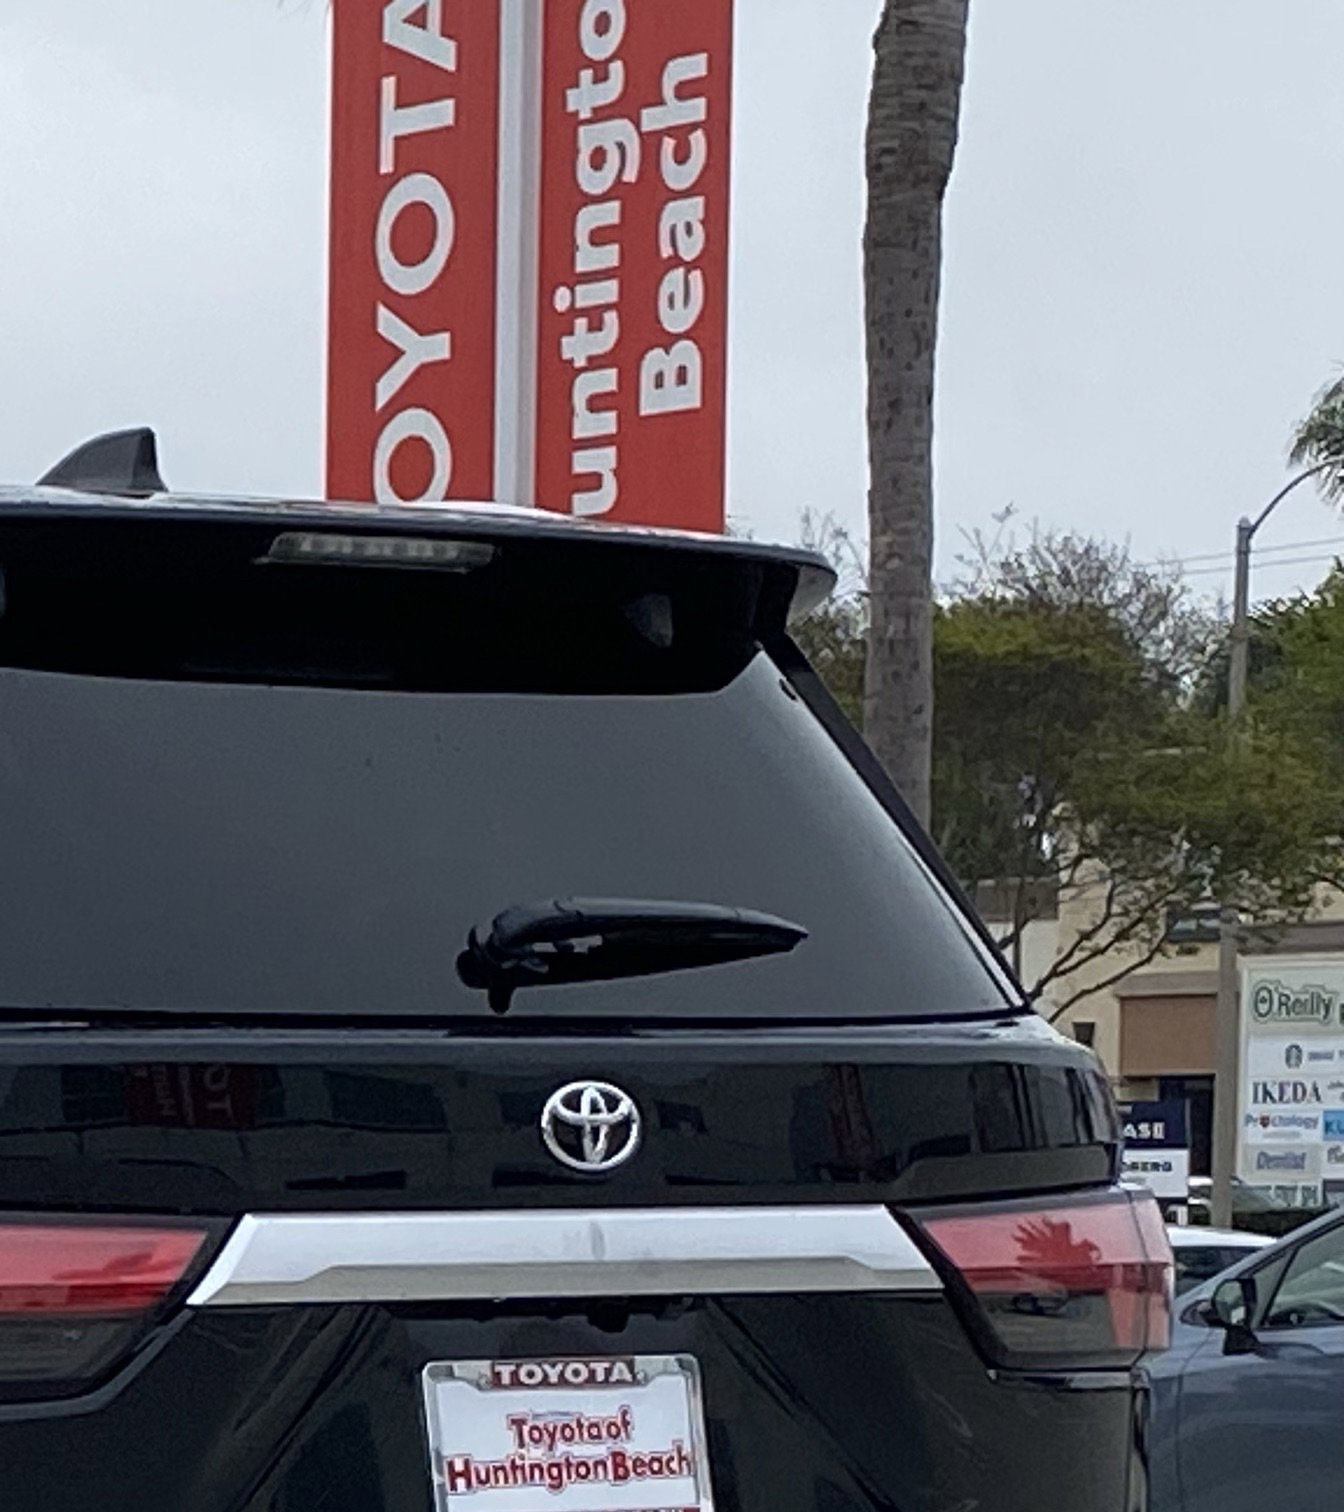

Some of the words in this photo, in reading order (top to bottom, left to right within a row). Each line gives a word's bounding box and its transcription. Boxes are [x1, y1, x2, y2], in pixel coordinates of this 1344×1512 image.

[373, 0, 458, 502] OYOTA
[553, 0, 640, 516] untingto
[638, 52, 709, 417] Beach
[1252, 1081, 1322, 1104] IKEDA
[493, 1360, 634, 1386] TOYOTA
[510, 1414, 602, 1454] Toyota
[605, 1408, 632, 1440] of
[446, 1452, 609, 1492] Huntington
[610, 1445, 692, 1482] Beach
